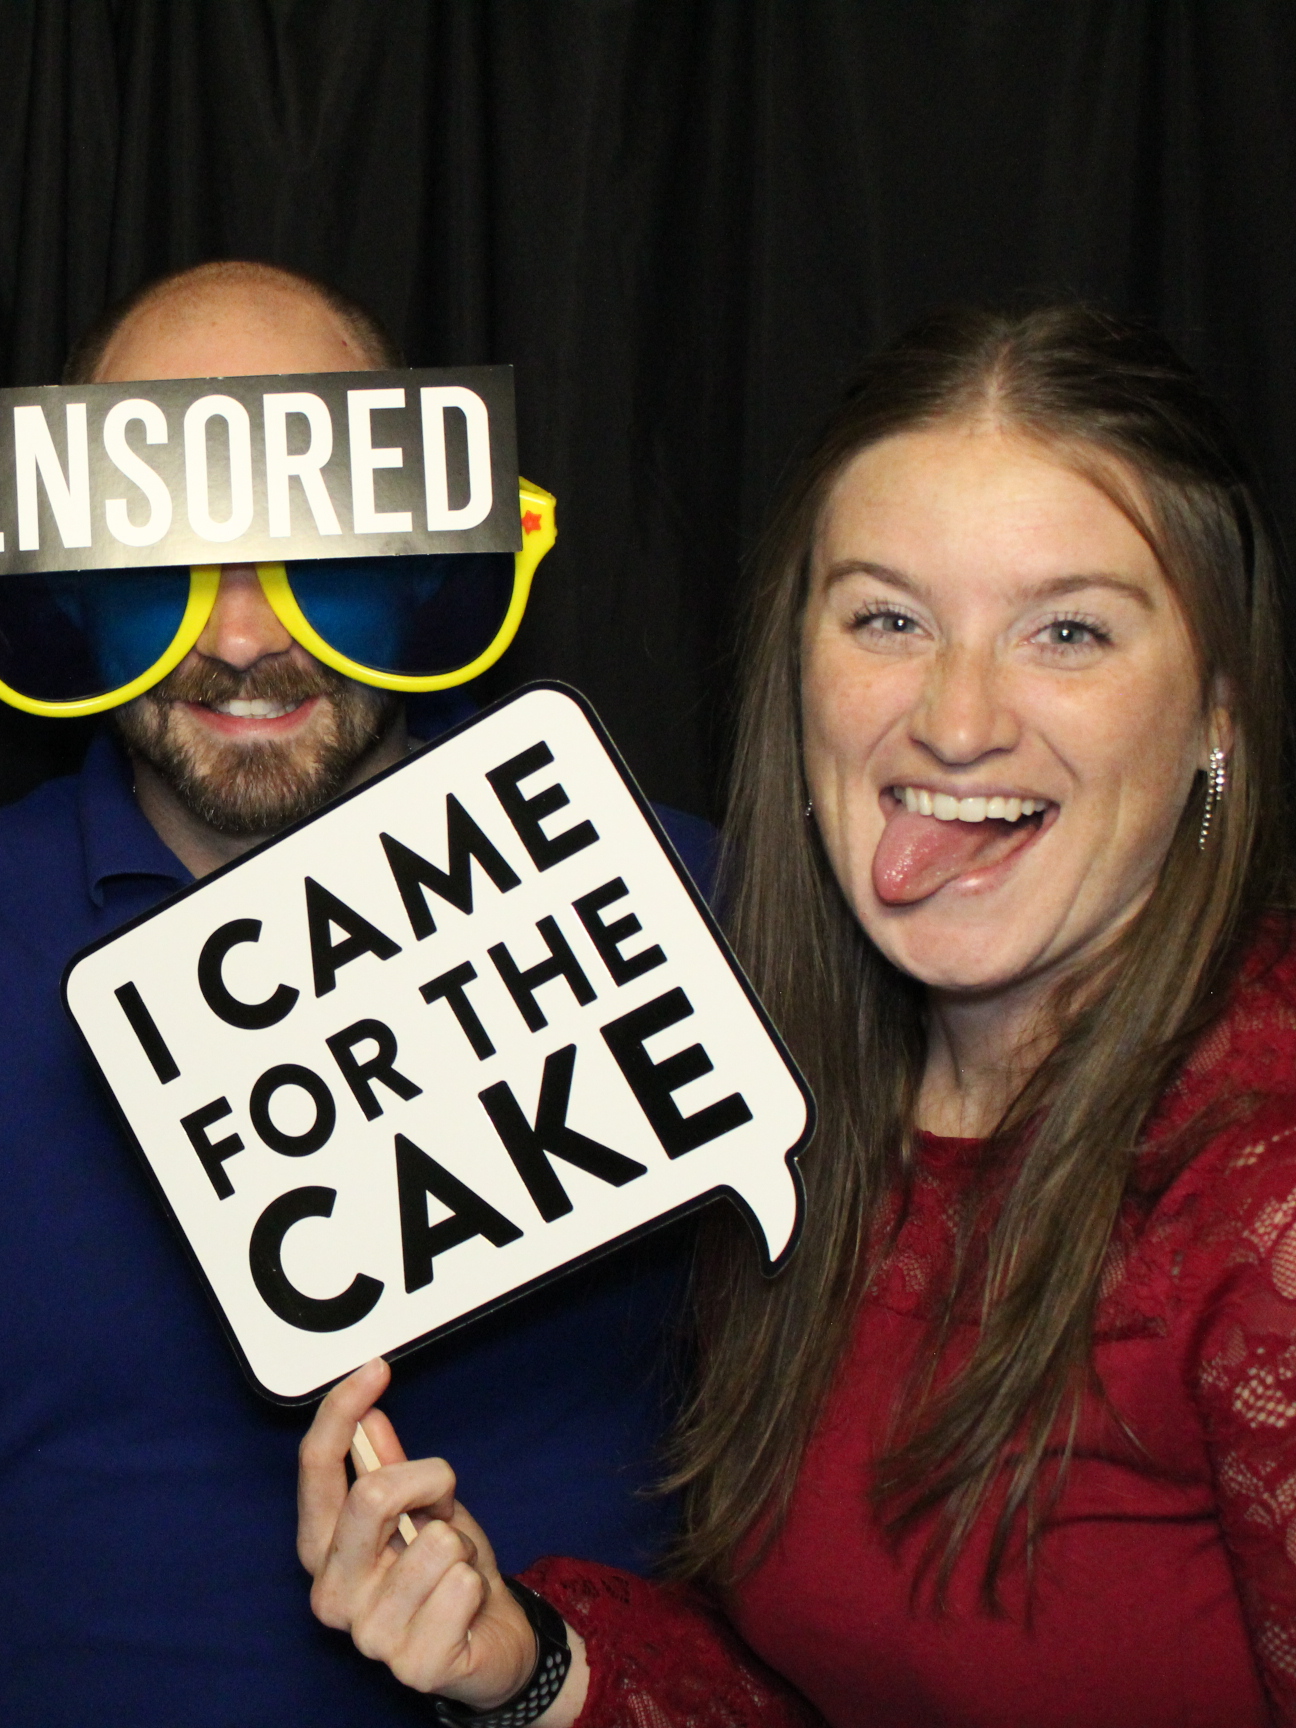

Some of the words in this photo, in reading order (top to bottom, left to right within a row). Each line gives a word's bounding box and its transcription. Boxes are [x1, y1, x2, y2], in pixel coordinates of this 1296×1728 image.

[114, 981, 181, 1085] I
[197, 740, 600, 1030] CAME
[180, 1018, 423, 1201] FOR
[418, 876, 668, 1061] THE
[249, 986, 754, 1334] CAKE
